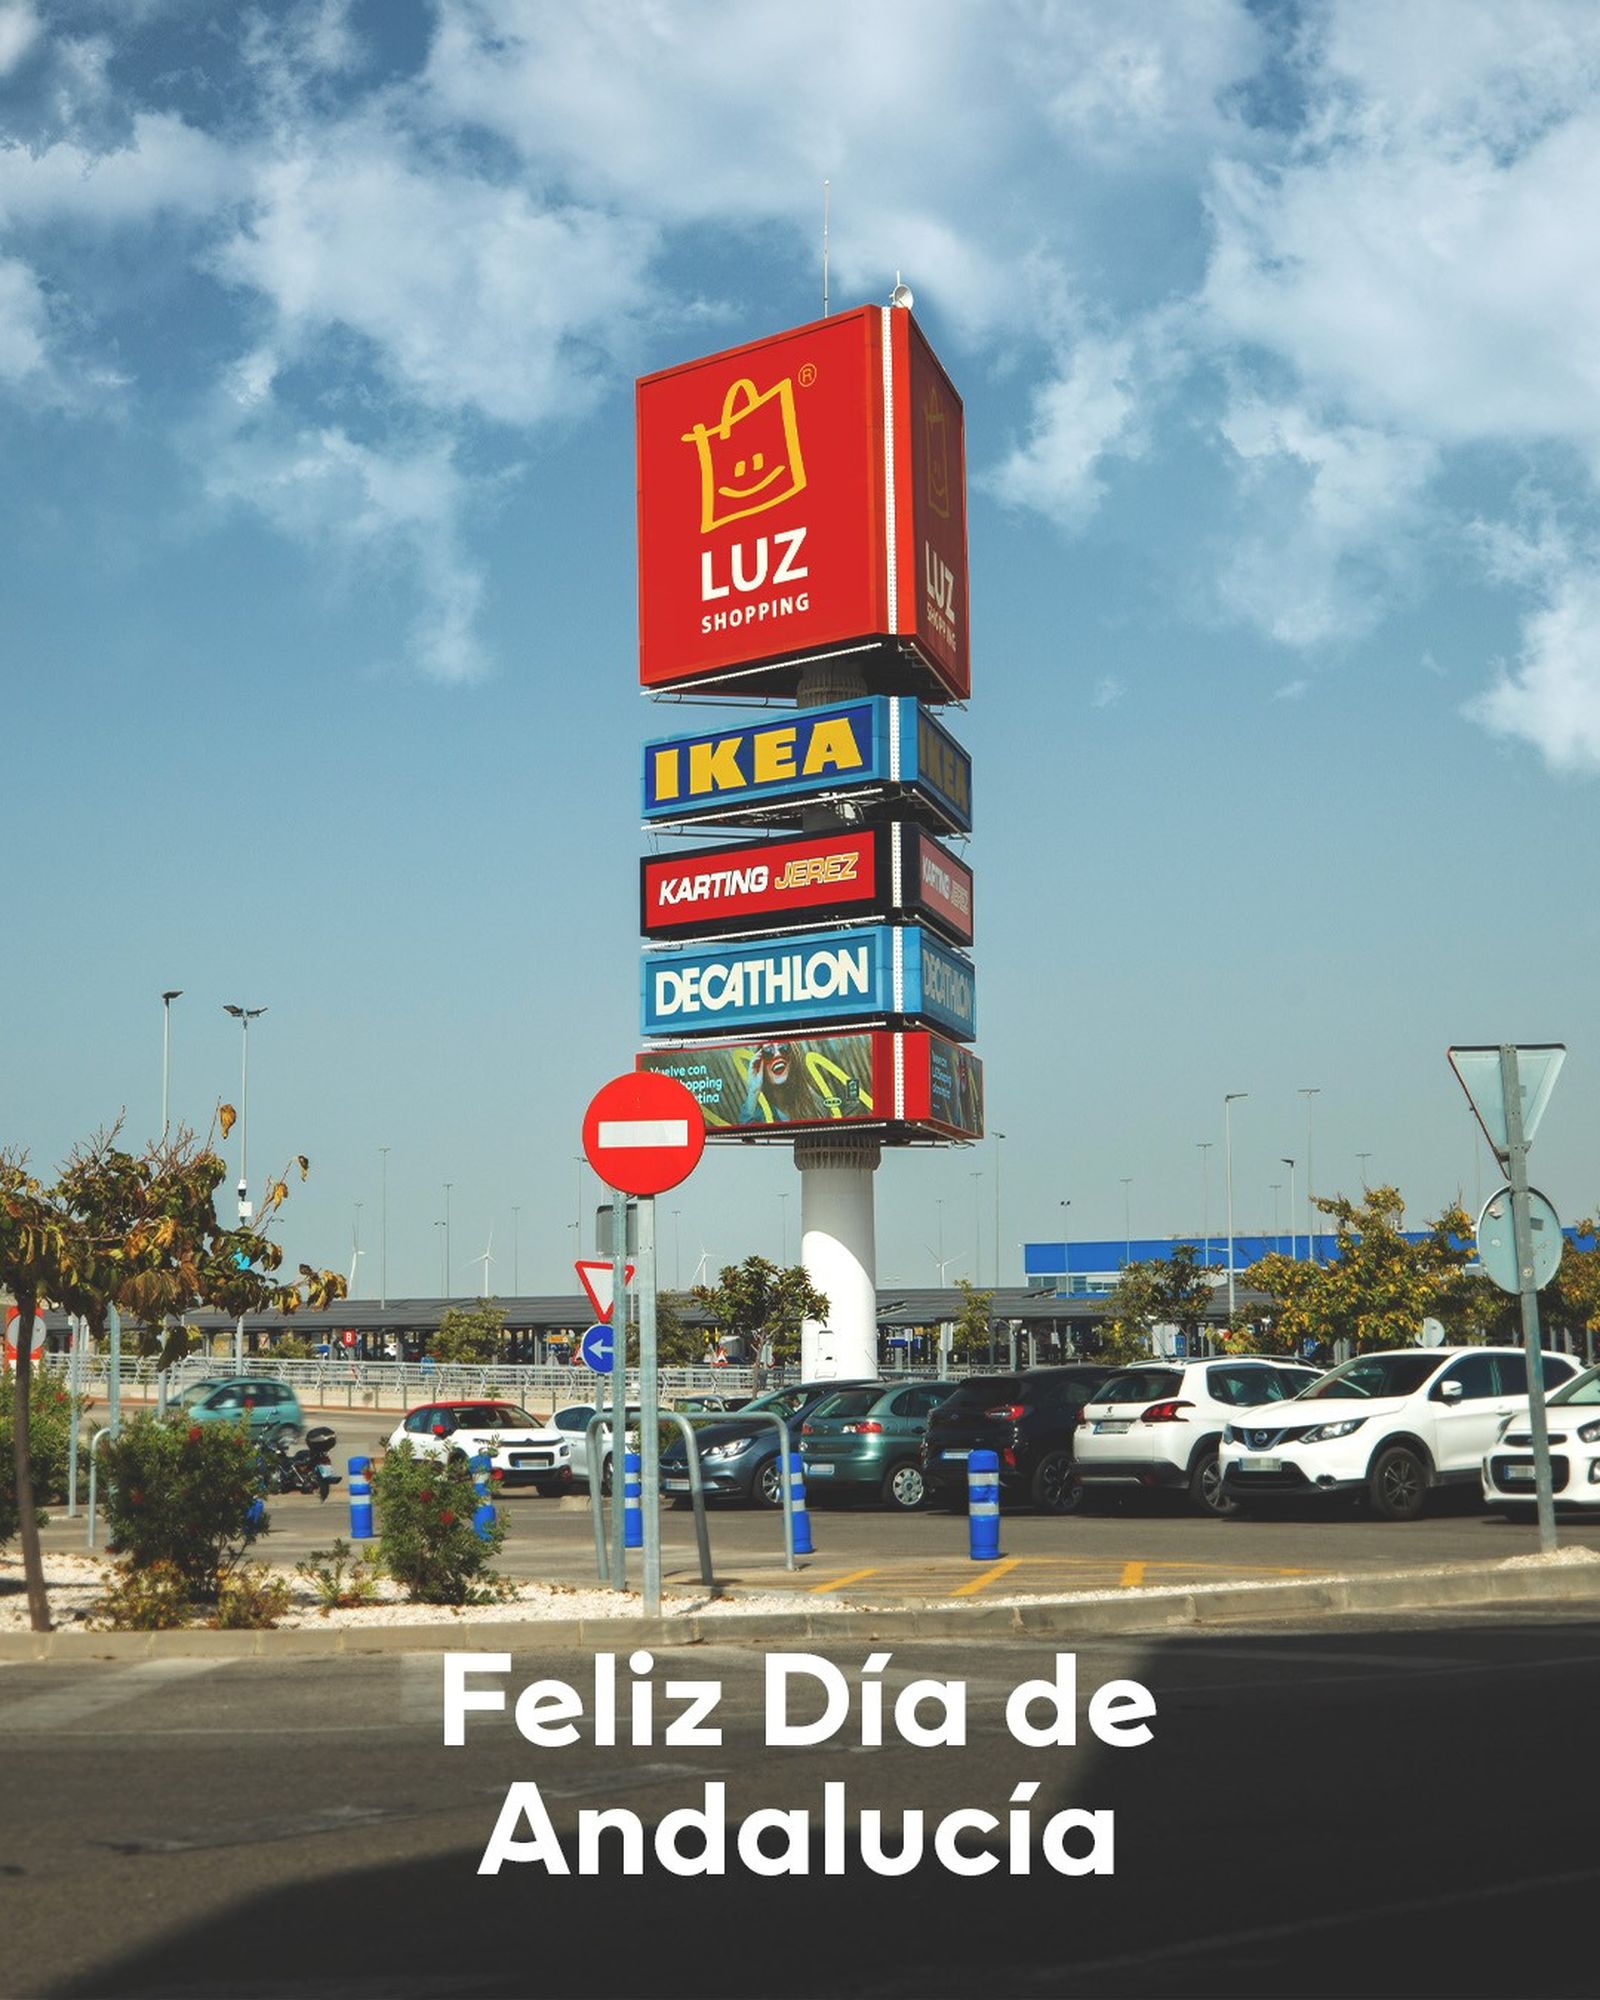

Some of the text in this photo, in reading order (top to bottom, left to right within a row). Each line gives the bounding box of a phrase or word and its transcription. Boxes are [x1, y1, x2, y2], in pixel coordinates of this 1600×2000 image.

[701, 527, 808, 602] LUZ
[925, 540, 955, 625] LUZ
[701, 593, 810, 634] SHOPPING
[655, 718, 862, 801] IKEA
[658, 851, 860, 906] KARTING JEREZ
[655, 946, 869, 1016] DECATHLON
[687, 1065, 707, 1076] con
[345, 1331, 352, 1342] B
